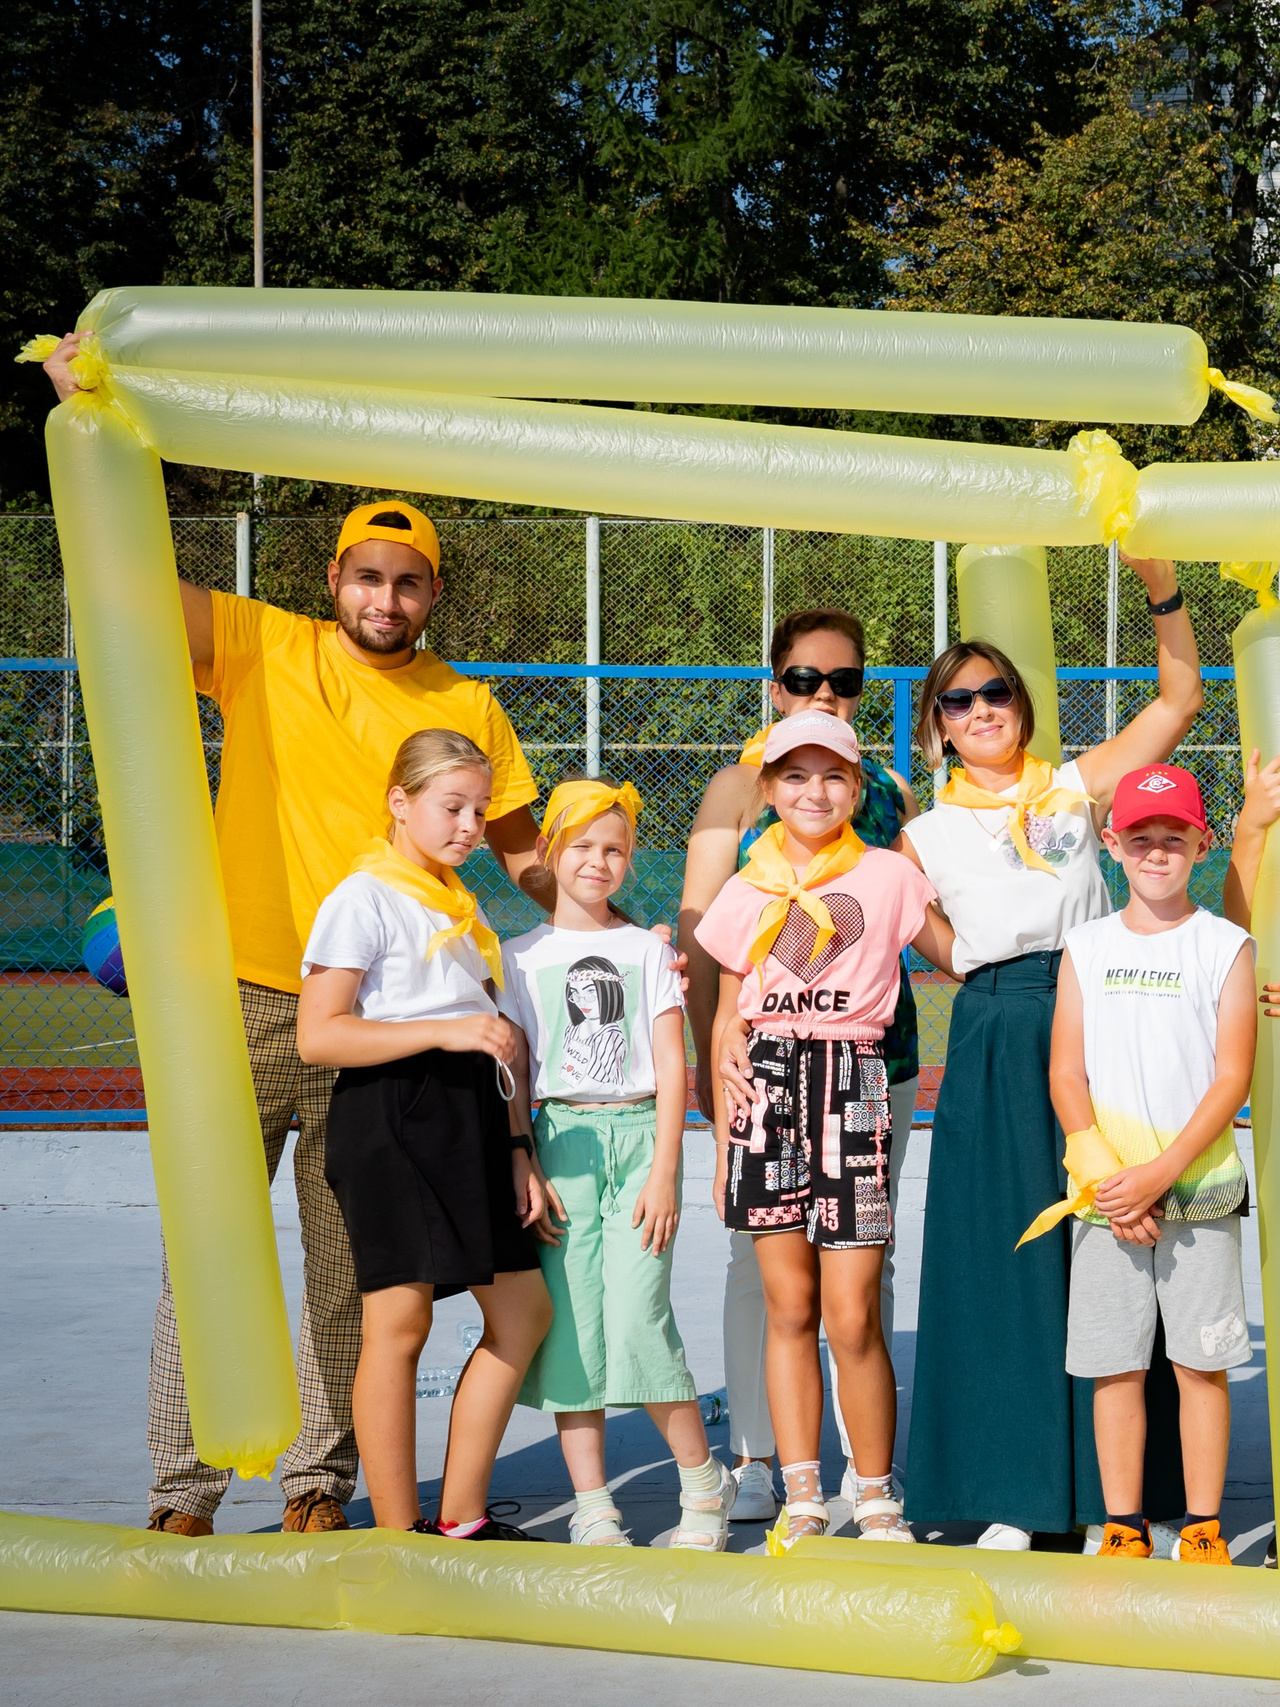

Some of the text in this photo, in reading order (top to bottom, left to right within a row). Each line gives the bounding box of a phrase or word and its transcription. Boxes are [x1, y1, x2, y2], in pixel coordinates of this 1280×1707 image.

[1104, 968, 1182, 989] NEW LEVEL
[761, 989, 851, 1014] DANCE
[567, 1047, 589, 1065] WILD
[844, 1101, 853, 1132] NOW
[765, 1161, 774, 1191] NOW
[828, 1197, 839, 1231] CAN
